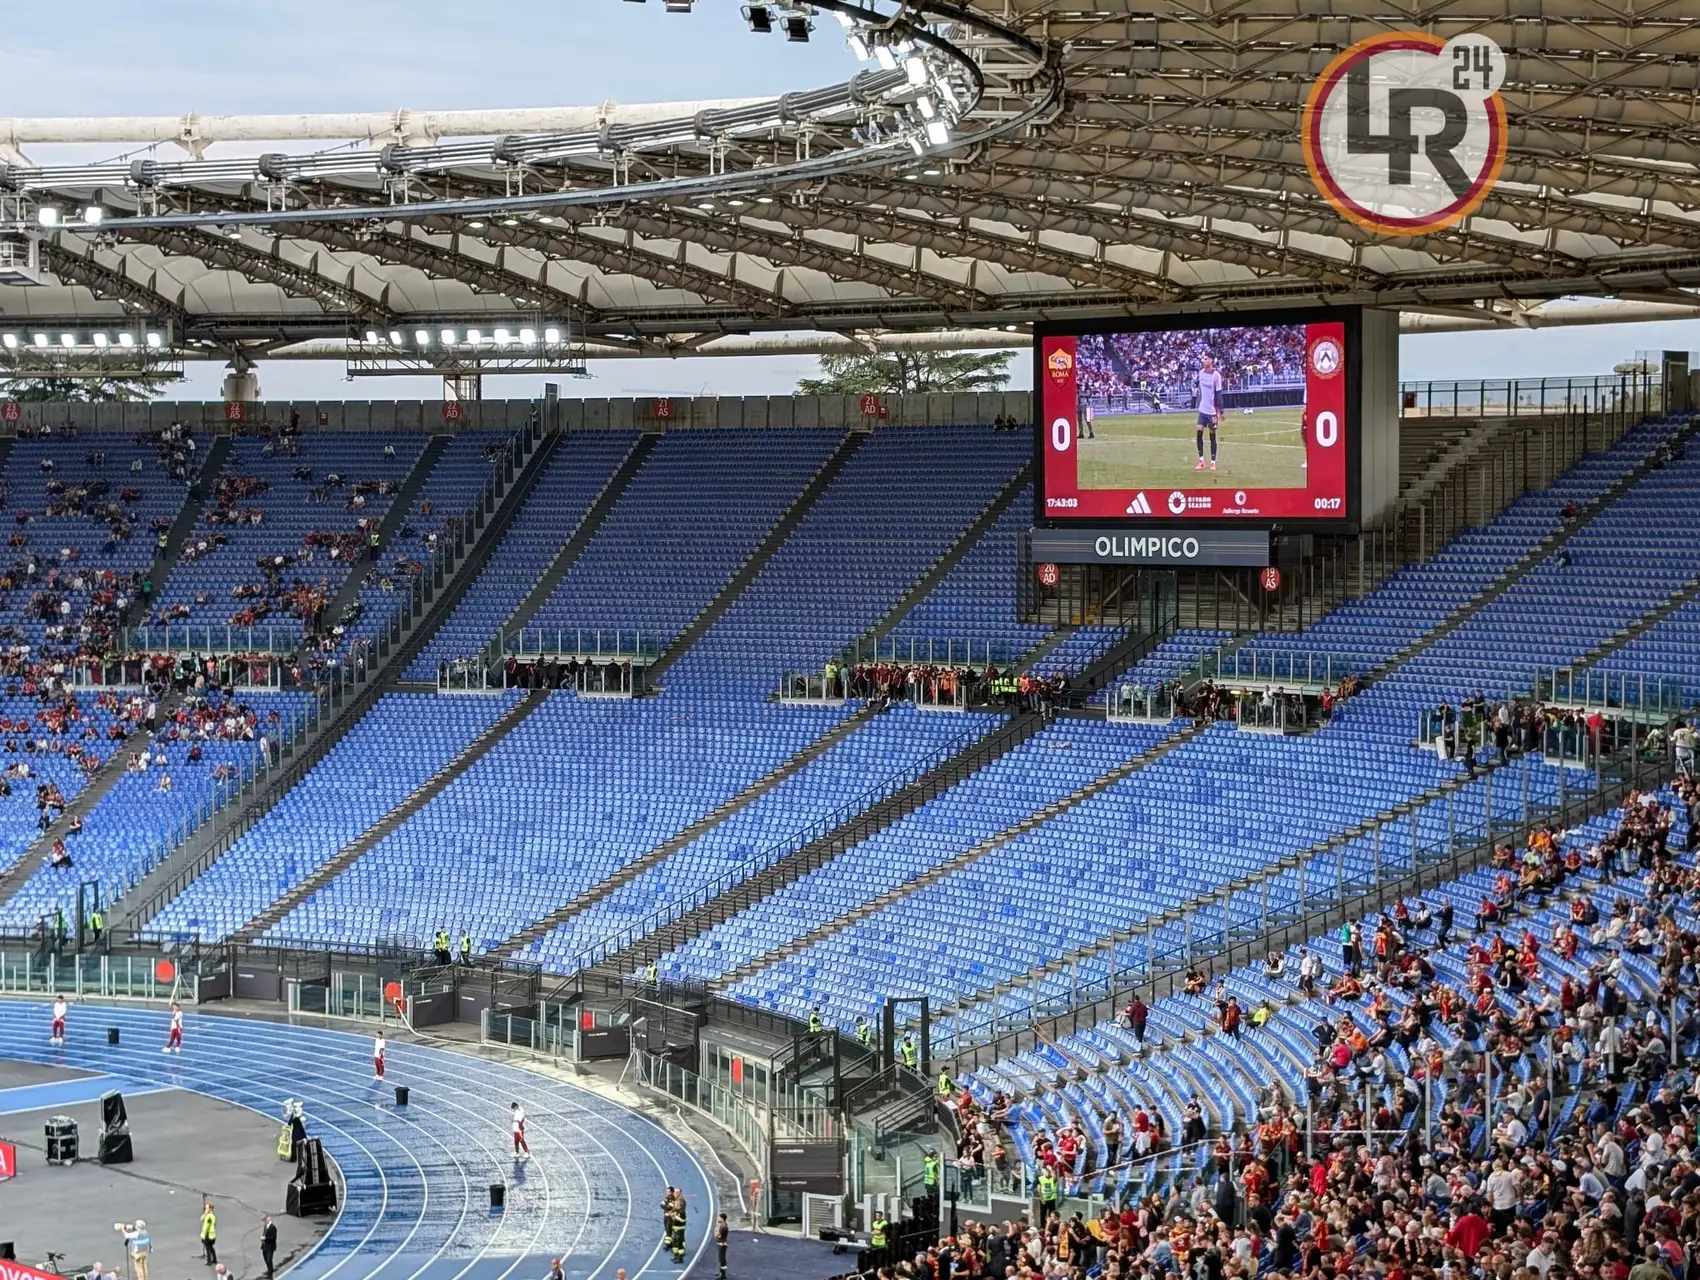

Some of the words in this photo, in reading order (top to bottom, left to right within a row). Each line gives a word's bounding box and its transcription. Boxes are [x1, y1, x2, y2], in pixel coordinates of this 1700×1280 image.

[230, 401, 240, 410] 22
[865, 396, 875, 405] 21
[229, 410, 241, 419] AS
[446, 410, 458, 418] AD
[658, 407, 669, 417] AS
[864, 405, 876, 414] AD
[5, 411, 18, 420] AD
[1316, 411, 1338, 447] 0
[1052, 418, 1071, 452] 0
[1046, 498, 1078, 508] 17:43:03
[1314, 498, 1341, 509] 00:17
[1094, 536, 1200, 558] OLIMPICO
[1044, 563, 1055, 573] 20
[1266, 567, 1275, 577] 19
[1043, 572, 1056, 583] AD
[1265, 577, 1276, 589] AS
